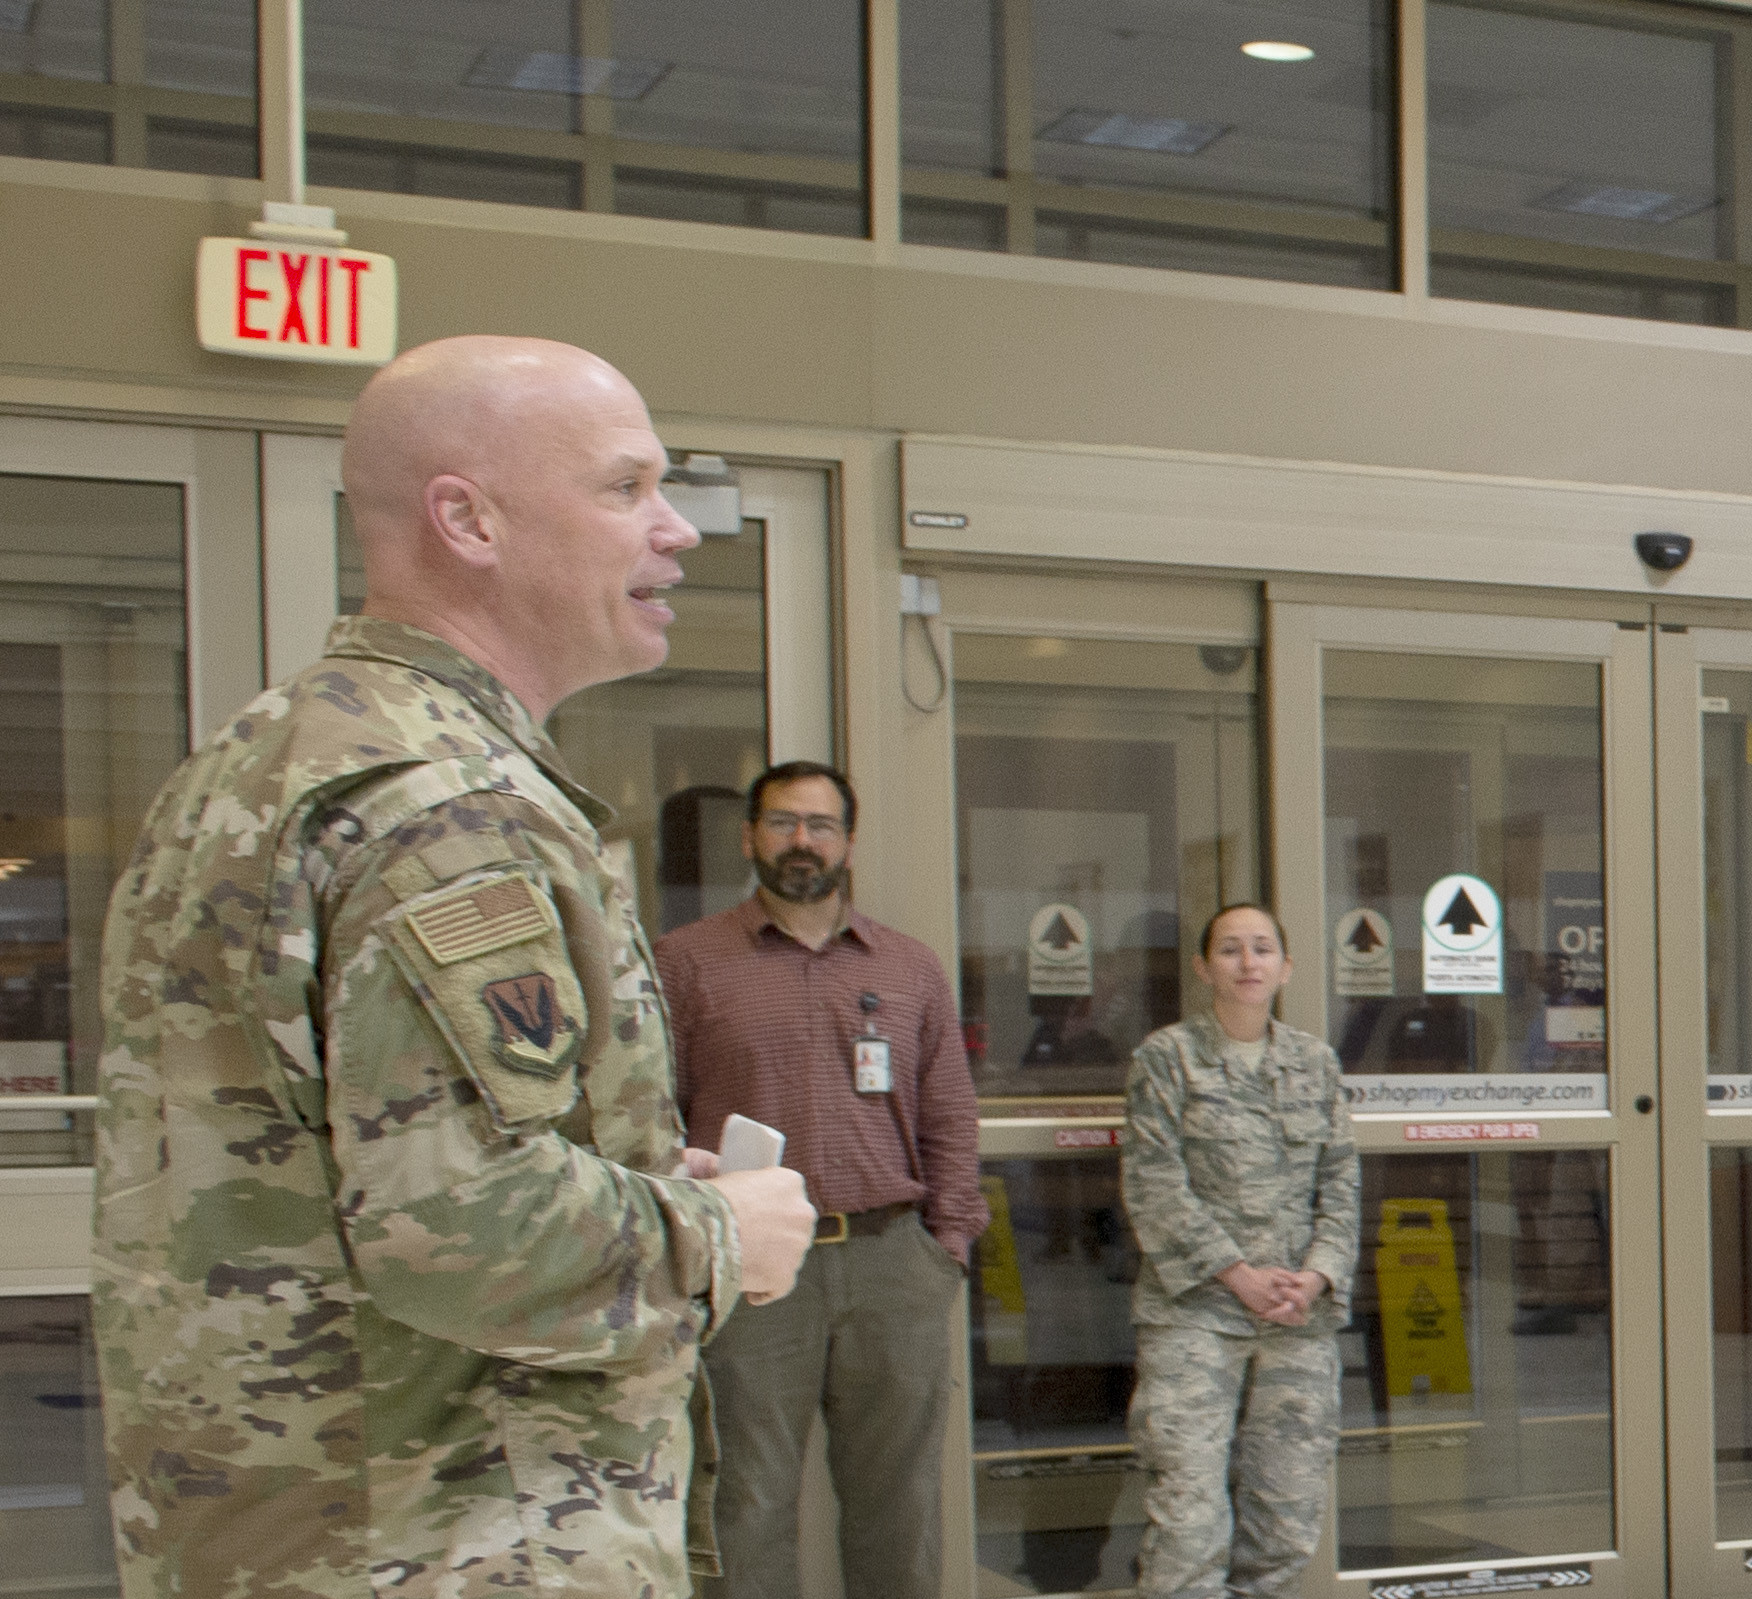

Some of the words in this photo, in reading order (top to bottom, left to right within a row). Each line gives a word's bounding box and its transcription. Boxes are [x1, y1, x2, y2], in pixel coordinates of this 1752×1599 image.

[235, 249, 371, 350] EXIT
[1369, 1080, 1594, 1107] shopmyexchange.com
[1419, 1125, 1481, 1138] EMERGENCY
[1482, 1124, 1511, 1137] PUSH
[1512, 1123, 1539, 1138] OPEN
